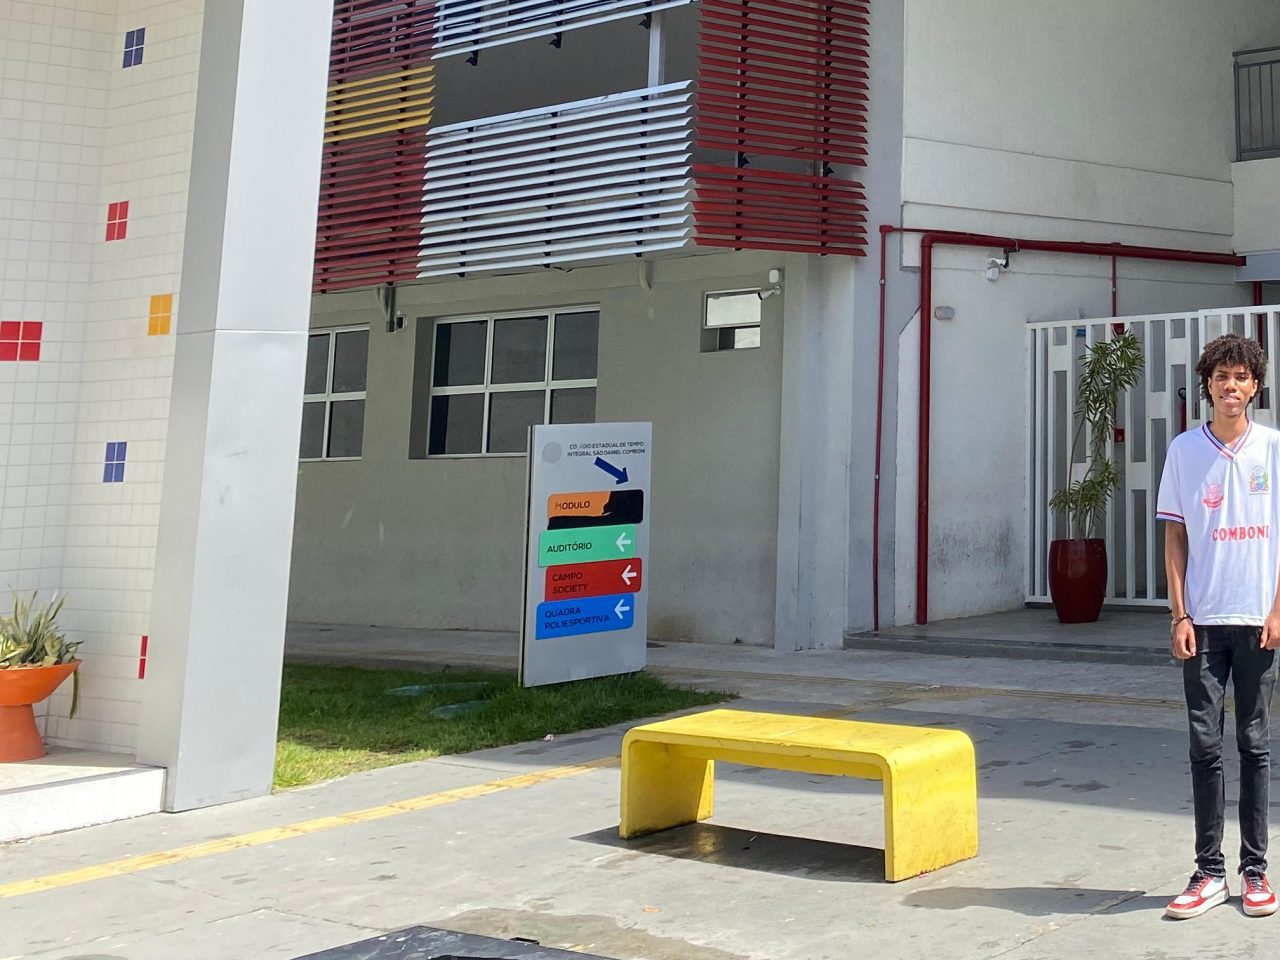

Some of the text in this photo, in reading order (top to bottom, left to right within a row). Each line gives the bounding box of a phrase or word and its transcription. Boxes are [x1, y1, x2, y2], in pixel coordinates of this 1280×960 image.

[1212, 525, 1269, 541] COMBONI
[546, 541, 593, 553] AUDITÓRIO
[552, 571, 583, 582] CAMPO
[552, 583, 589, 594] SOCIETY
[544, 606, 581, 618] QUADRA
[544, 614, 610, 630] POLIESPORTIVA
